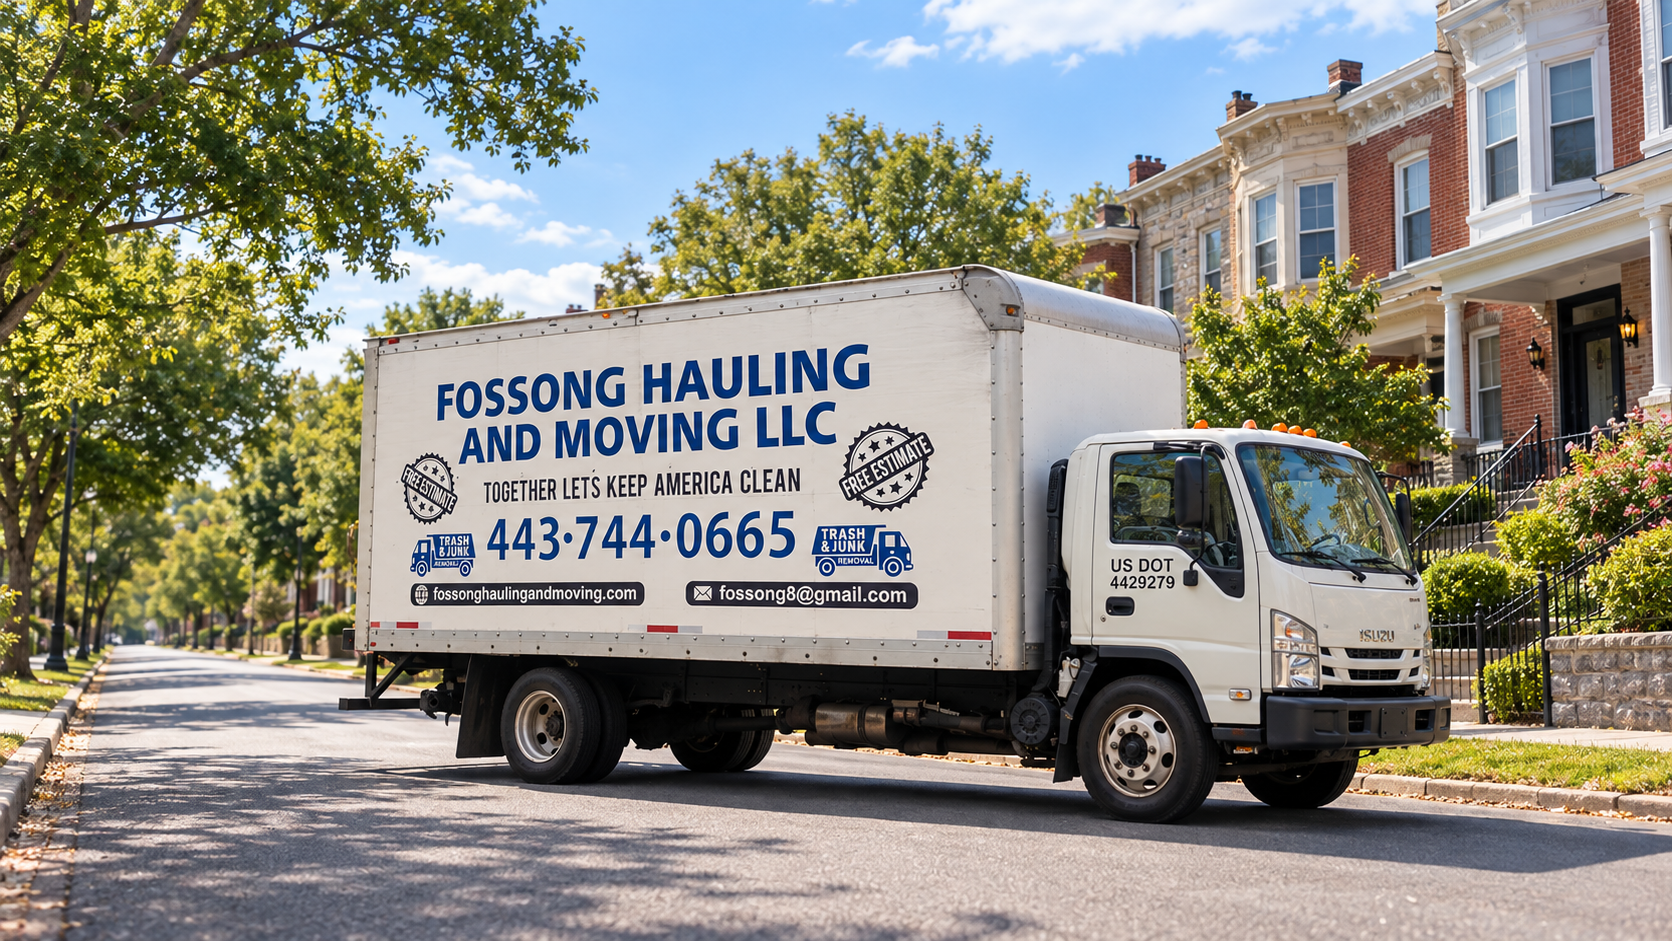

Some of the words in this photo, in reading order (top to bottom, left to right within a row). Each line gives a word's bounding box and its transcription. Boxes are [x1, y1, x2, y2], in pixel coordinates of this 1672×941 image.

[437, 367, 626, 421] FOSSONG
[643, 344, 870, 404] HAULING
[458, 423, 541, 465] AND
[555, 408, 739, 459] MOVING
[756, 401, 837, 448] LLC
[842, 468, 874, 498] FREE
[870, 435, 932, 482] ESTIMATE
[402, 466, 423, 490] FREE
[420, 477, 457, 512] ESTIMATE
[484, 478, 557, 504] TOGETHER
[607, 474, 648, 498] KEEP
[654, 471, 733, 496] AMERICA
[740, 467, 801, 494] CLEAN
[439, 535, 470, 547] TRASH
[821, 527, 865, 540] TRASH
[837, 557, 875, 565] REMOVAL
[1111, 558, 1133, 573] US
[1138, 558, 1174, 572] DOT
[1110, 575, 1176, 589] 4429279
[433, 585, 637, 604] fossonghaulingandmoving.com
[719, 584, 907, 605] fossong8@gmail.com
[1359, 629, 1395, 643] ISUZU
